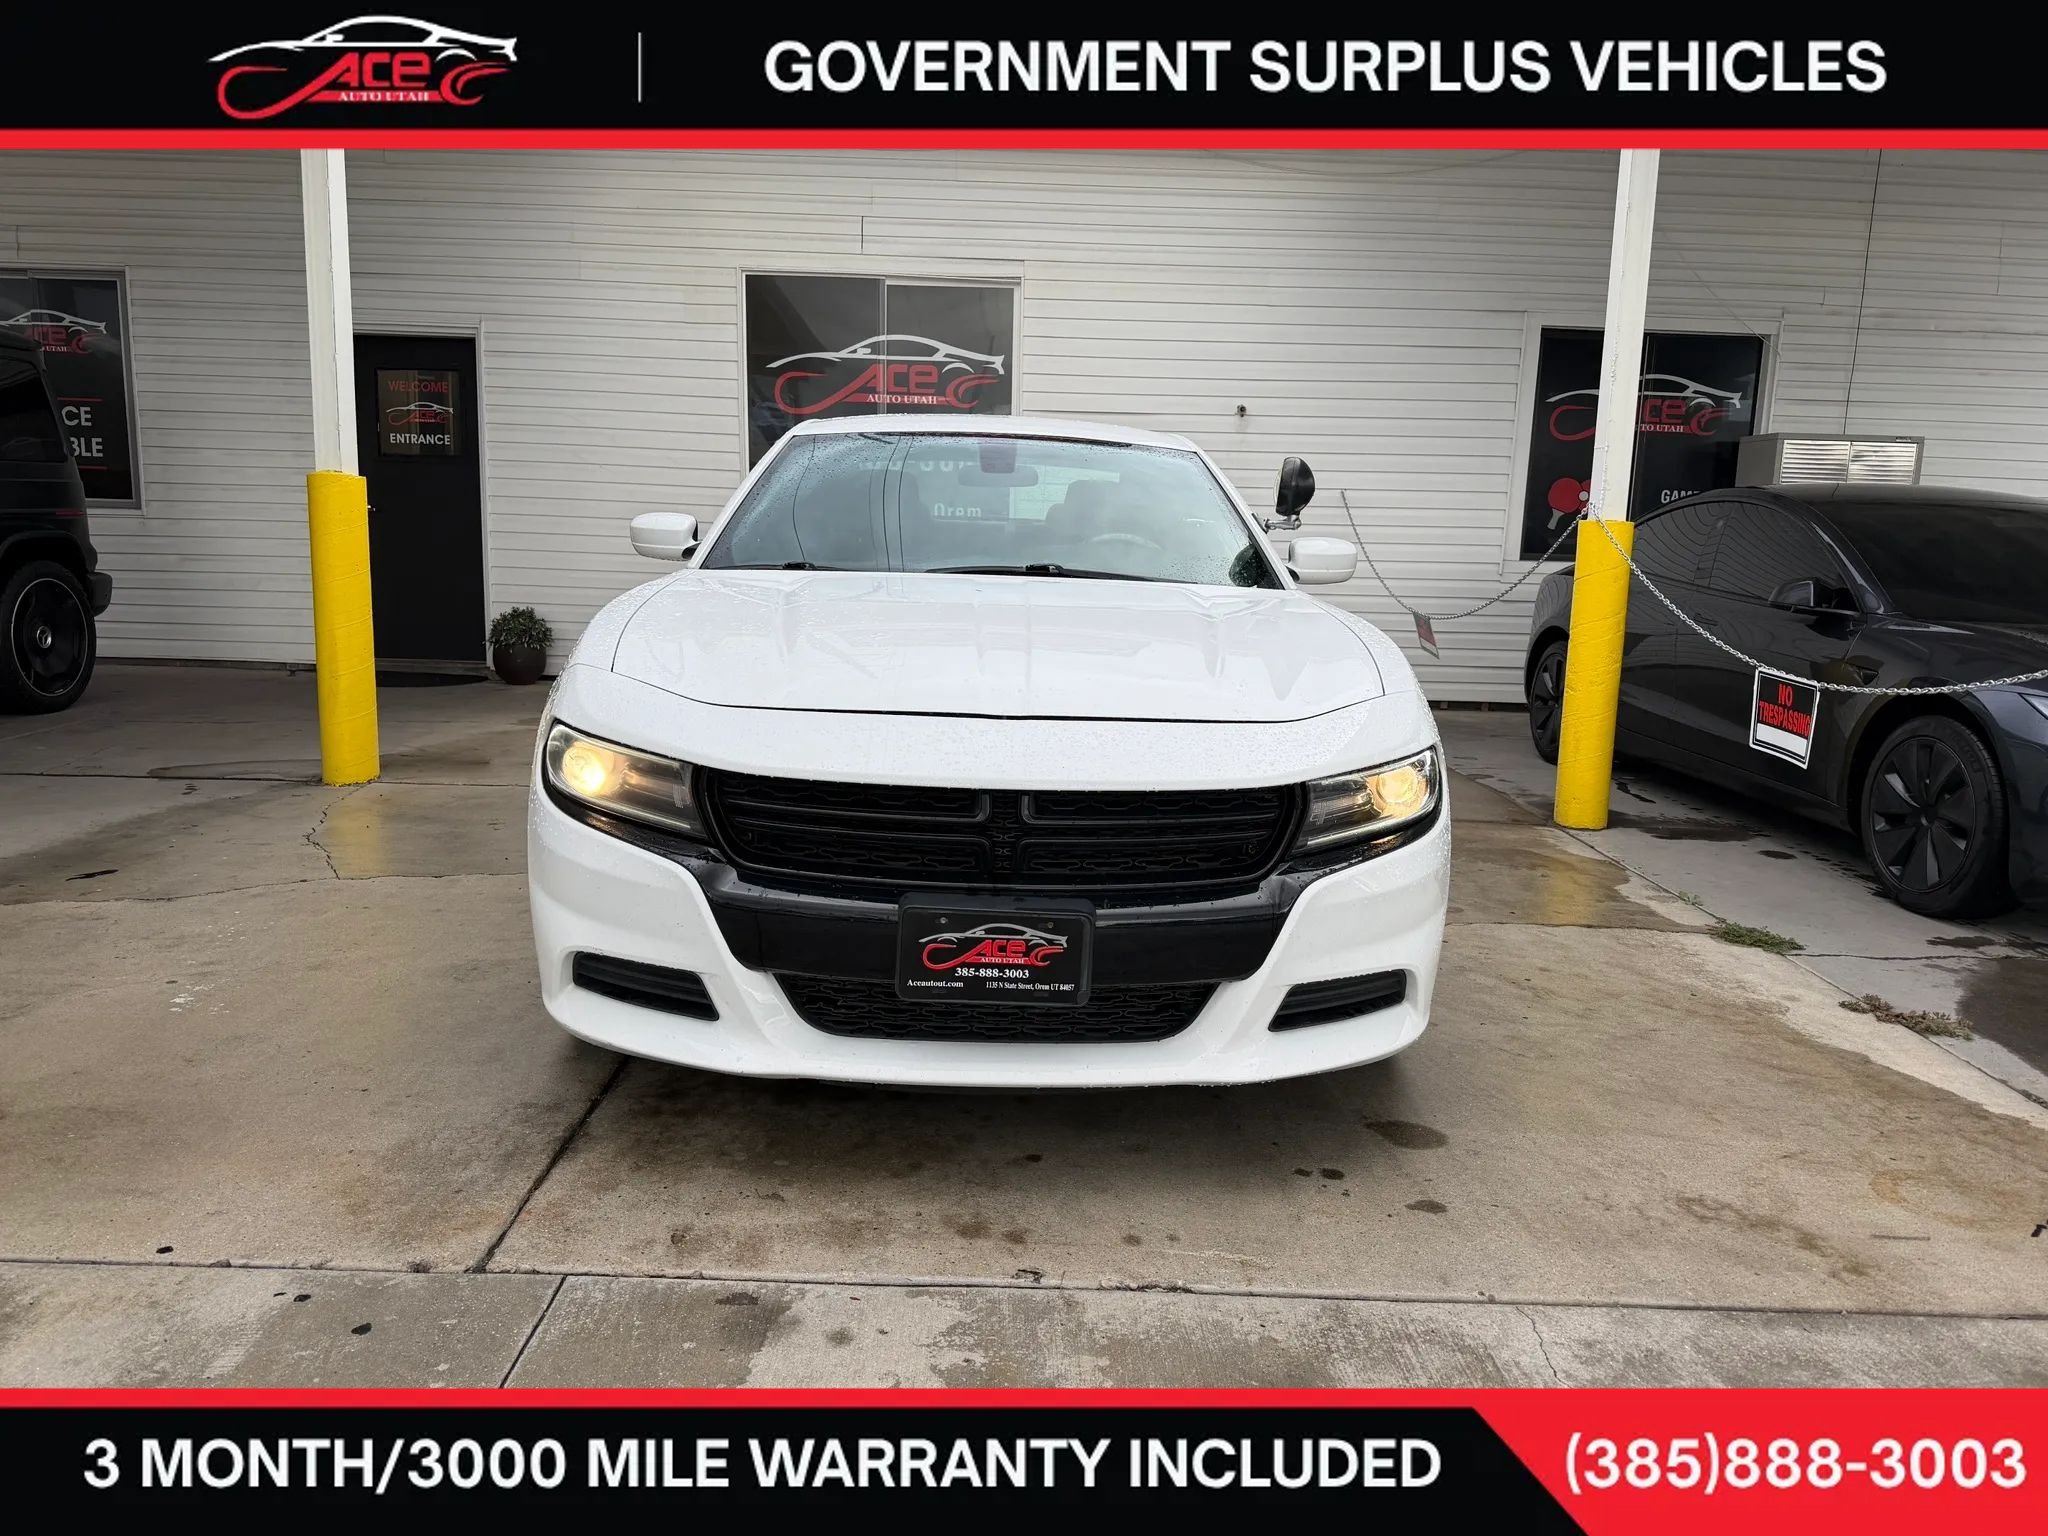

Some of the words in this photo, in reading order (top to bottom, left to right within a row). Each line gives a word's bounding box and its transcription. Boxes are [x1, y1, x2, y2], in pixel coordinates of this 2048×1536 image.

[388, 380, 449, 393] WELCOME
[866, 394, 902, 404] AUTO
[904, 395, 937, 405] UTAH
[1656, 424, 1684, 432] UTAH
[389, 432, 451, 445] ENTRANCE
[1777, 683, 1793, 706] NO
[1758, 700, 1811, 737] TRESPASSING
[954, 967, 1030, 979] 385-888-3003
[907, 979, 964, 988] Aceautout.com
[986, 981, 998, 989] 1135
[1017, 983, 1034, 991] Street,
[1050, 983, 1059, 991] UT
